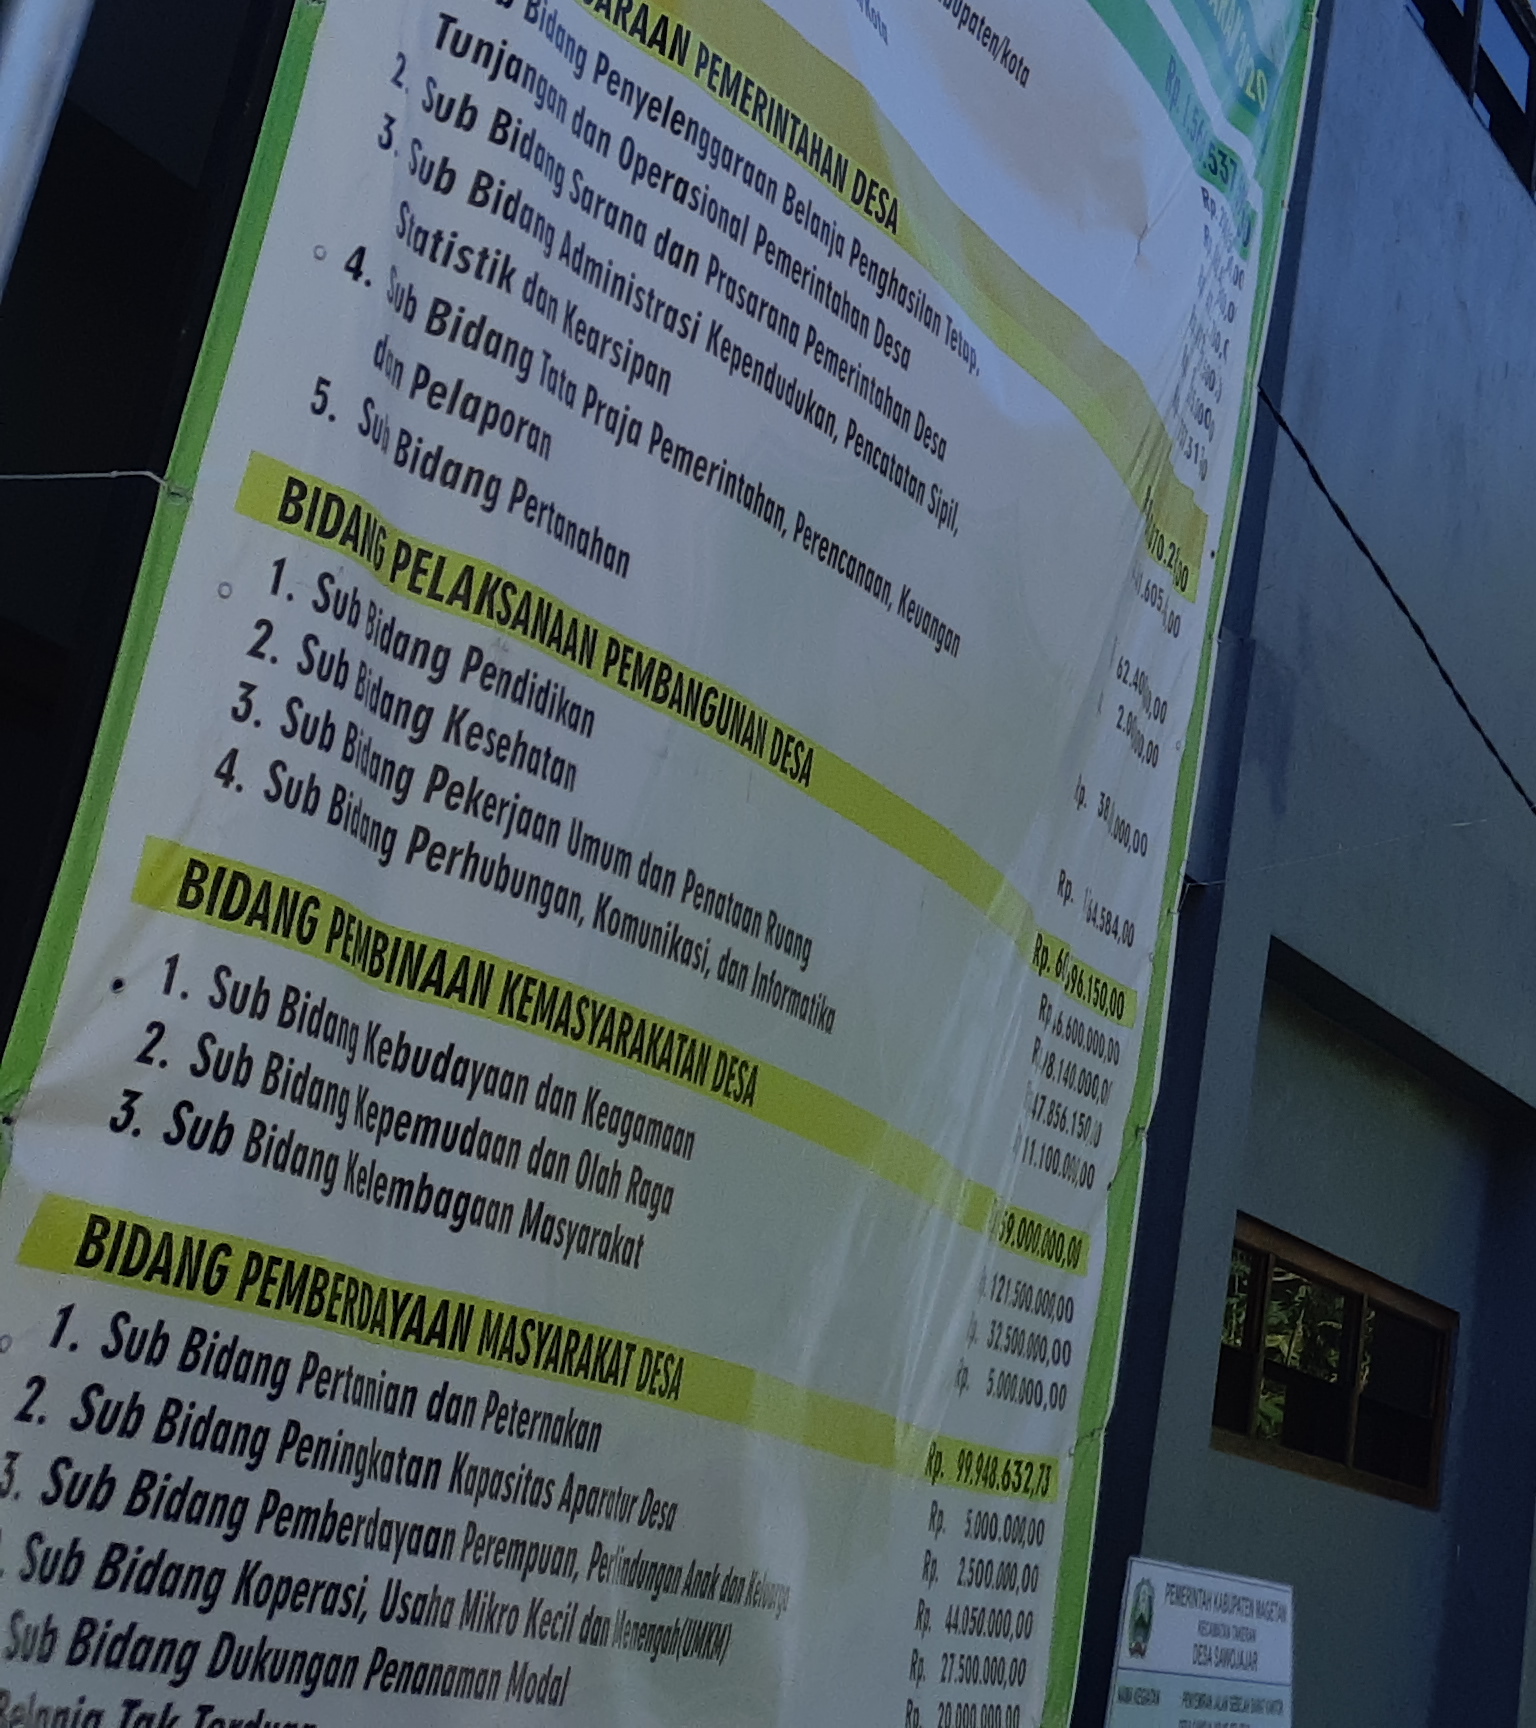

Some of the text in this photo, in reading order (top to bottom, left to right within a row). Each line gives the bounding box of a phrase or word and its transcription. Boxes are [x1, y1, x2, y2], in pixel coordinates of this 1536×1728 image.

[434, 12, 911, 371] Tunjangan dan Operasional Pemerintahan Desa
[593, 50, 778, 205] Penyelenggaraan
[782, 181, 846, 259] Belanja
[849, 238, 941, 337] Penghasilan
[694, 40, 848, 193] PEMERINTAHAN
[851, 168, 900, 235] DESA
[396, 200, 672, 397] Statistik dan Kearsipan
[569, 168, 947, 461] Sarana dan Prasarana Pemerintahan Desa
[373, 333, 553, 461] dan Pelaporan
[558, 229, 960, 538] Administrasi Kependudukan, Pencatatan Sipil,
[507, 476, 631, 579] Pertanahan
[539, 349, 961, 658] Tata Praja Pemerintahan, Perencanaan, Keuangan
[277, 476, 815, 788] BIDANG PELAKSANAAN PEMBANGUNAN DESA
[459, 645, 596, 739] Pendidikan
[441, 703, 578, 793] Kesehatan
[263, 759, 837, 1035] Sub Bidang Perhubungan, Komunikasi, dan Informatika
[422, 764, 813, 972] Pekerjaan Umum dan Penataan Ruang
[176, 857, 759, 1108] BIDANG PEMBINAAN KEMASYARAKATAN DESA
[354, 1084, 675, 1222] Kepemudaan dan Olah Raga
[363, 1020, 695, 1161] Kebudayaan dan Keagamaan
[344, 1148, 646, 1270] Kelembagaan Masyarakat
[74, 1213, 686, 1401] BIDANG PEMBERDAYAAN MASYARAKAT DESA
[69, 1383, 679, 1532] Sub Bidang Peningkatan Kapasitas Aparatur Desa
[296, 1350, 603, 1453] Pertanian dan Peternakan
[231, 1559, 369, 1624] Koperasi,
[378, 1577, 454, 1629] Usaha
[457, 1587, 520, 1637] Mikro
[523, 1596, 578, 1644] Kecil
[578, 1603, 610, 1647] dan
[254, 1487, 456, 1565] Pemberdayaan
[460, 1520, 580, 1584] Perempuan,
[681, 1558, 720, 1601] Anak
[718, 1565, 746, 1604] dan
[204, 1630, 571, 1707] Dukungan Penanaman Modal
